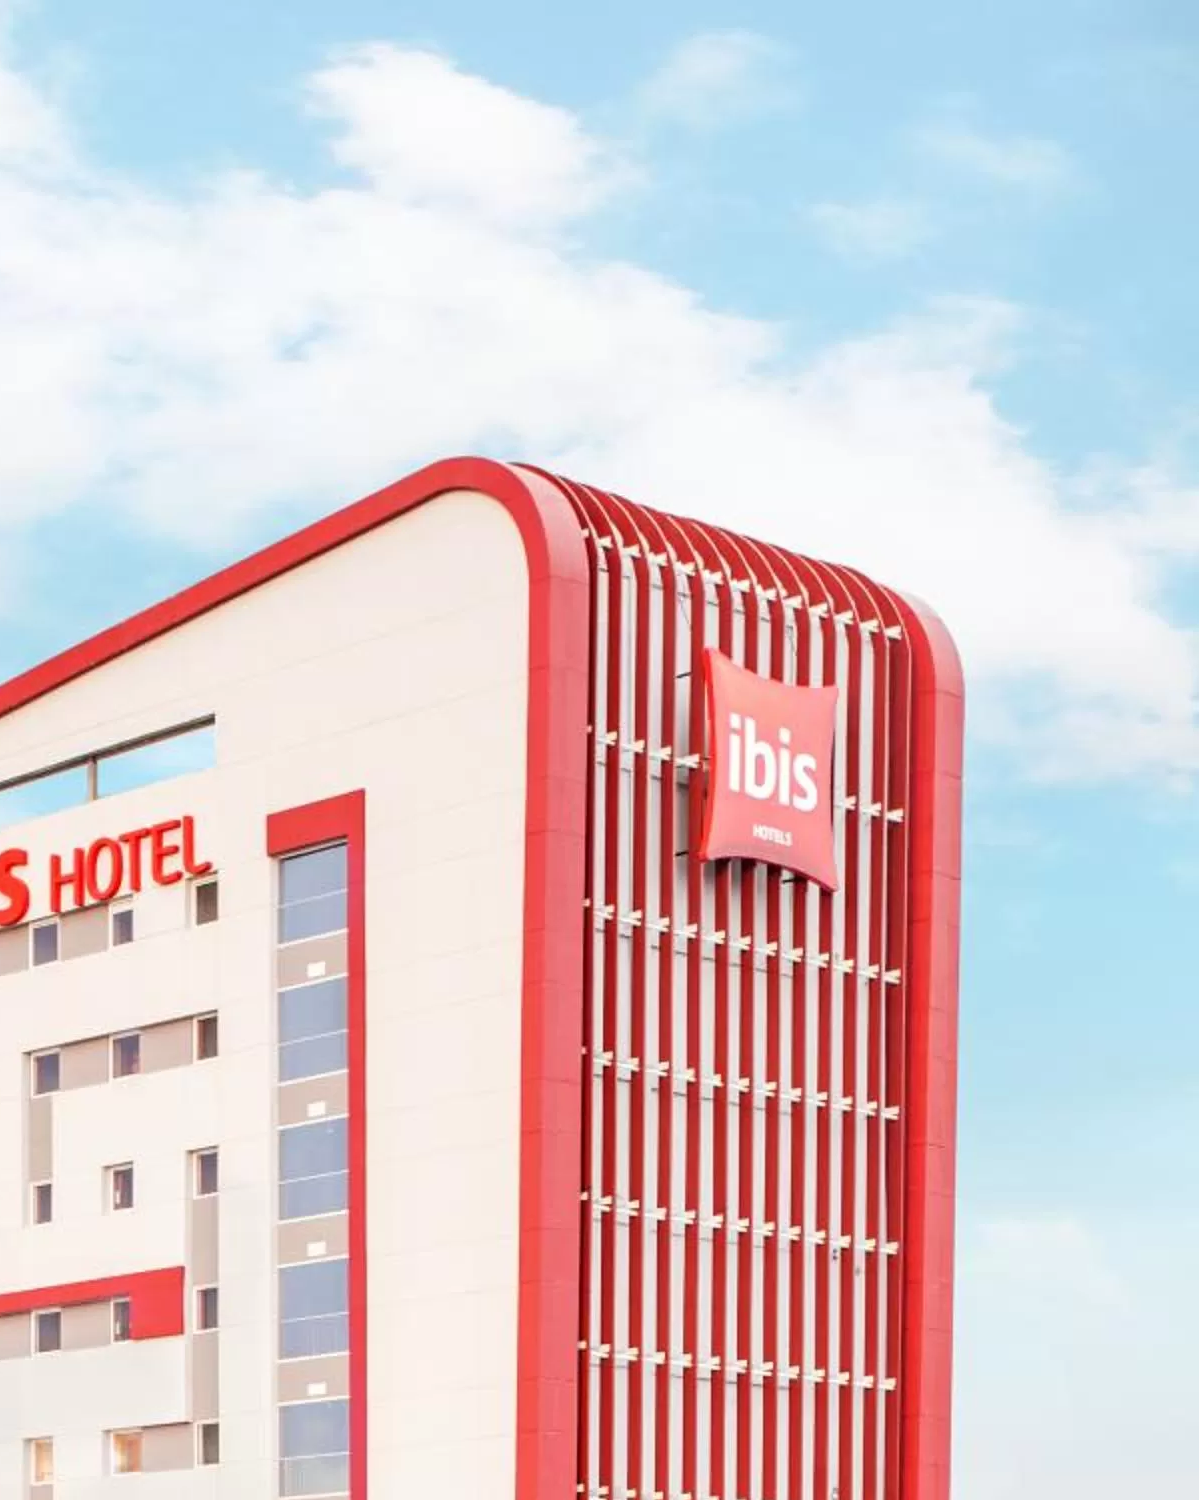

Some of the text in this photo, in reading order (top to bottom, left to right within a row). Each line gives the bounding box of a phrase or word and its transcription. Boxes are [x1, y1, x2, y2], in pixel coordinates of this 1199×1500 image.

[729, 713, 817, 812] ibis
[50, 815, 212, 913] HOTEL
[752, 824, 792, 846] HOTELS
